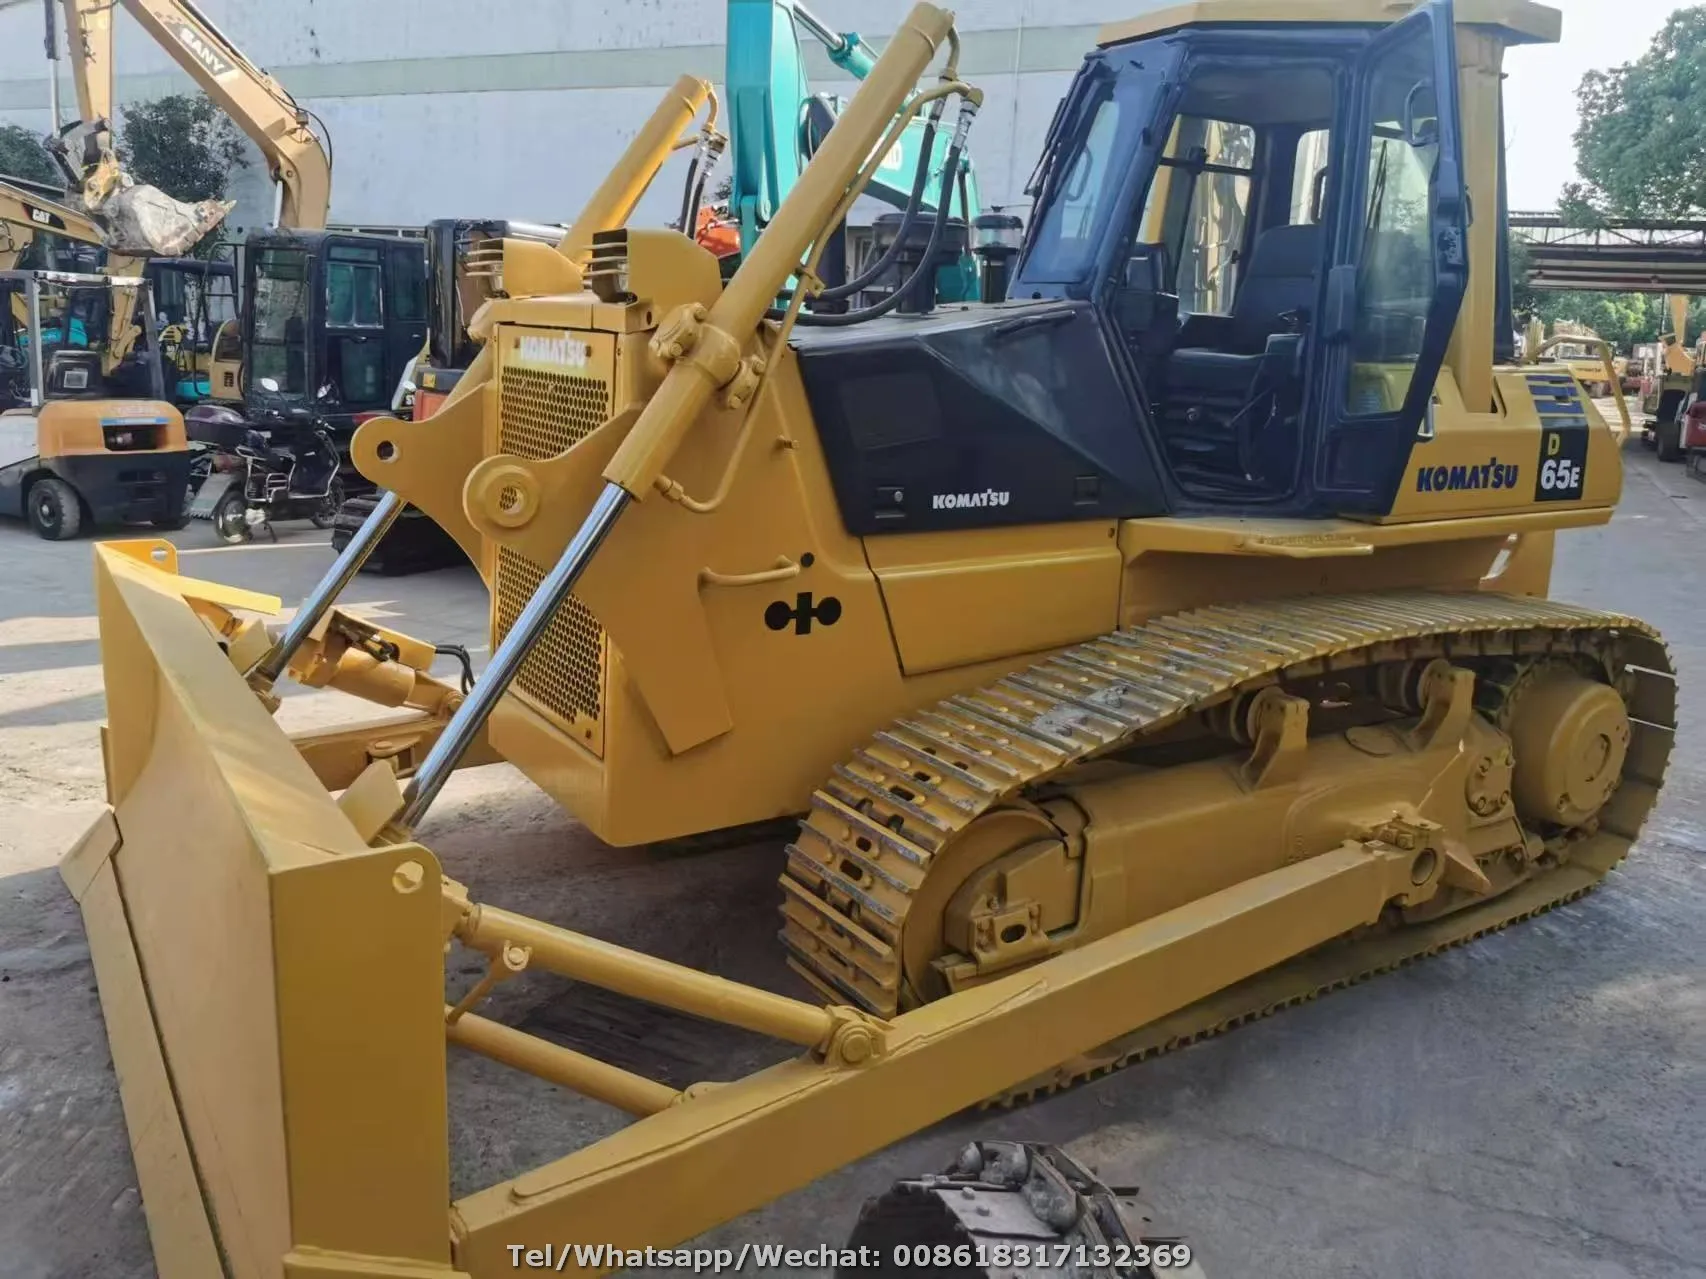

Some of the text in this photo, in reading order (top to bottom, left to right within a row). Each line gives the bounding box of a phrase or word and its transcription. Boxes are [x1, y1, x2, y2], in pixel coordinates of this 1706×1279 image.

[180, 27, 225, 72] SANY
[32, 208, 50, 224] CAT
[520, 330, 586, 366] KOMATSU
[1548, 433, 1560, 456] D
[1416, 457, 1519, 492] KOMATSU
[1541, 459, 1580, 490] 65E
[932, 488, 1010, 510] KOMATSU
